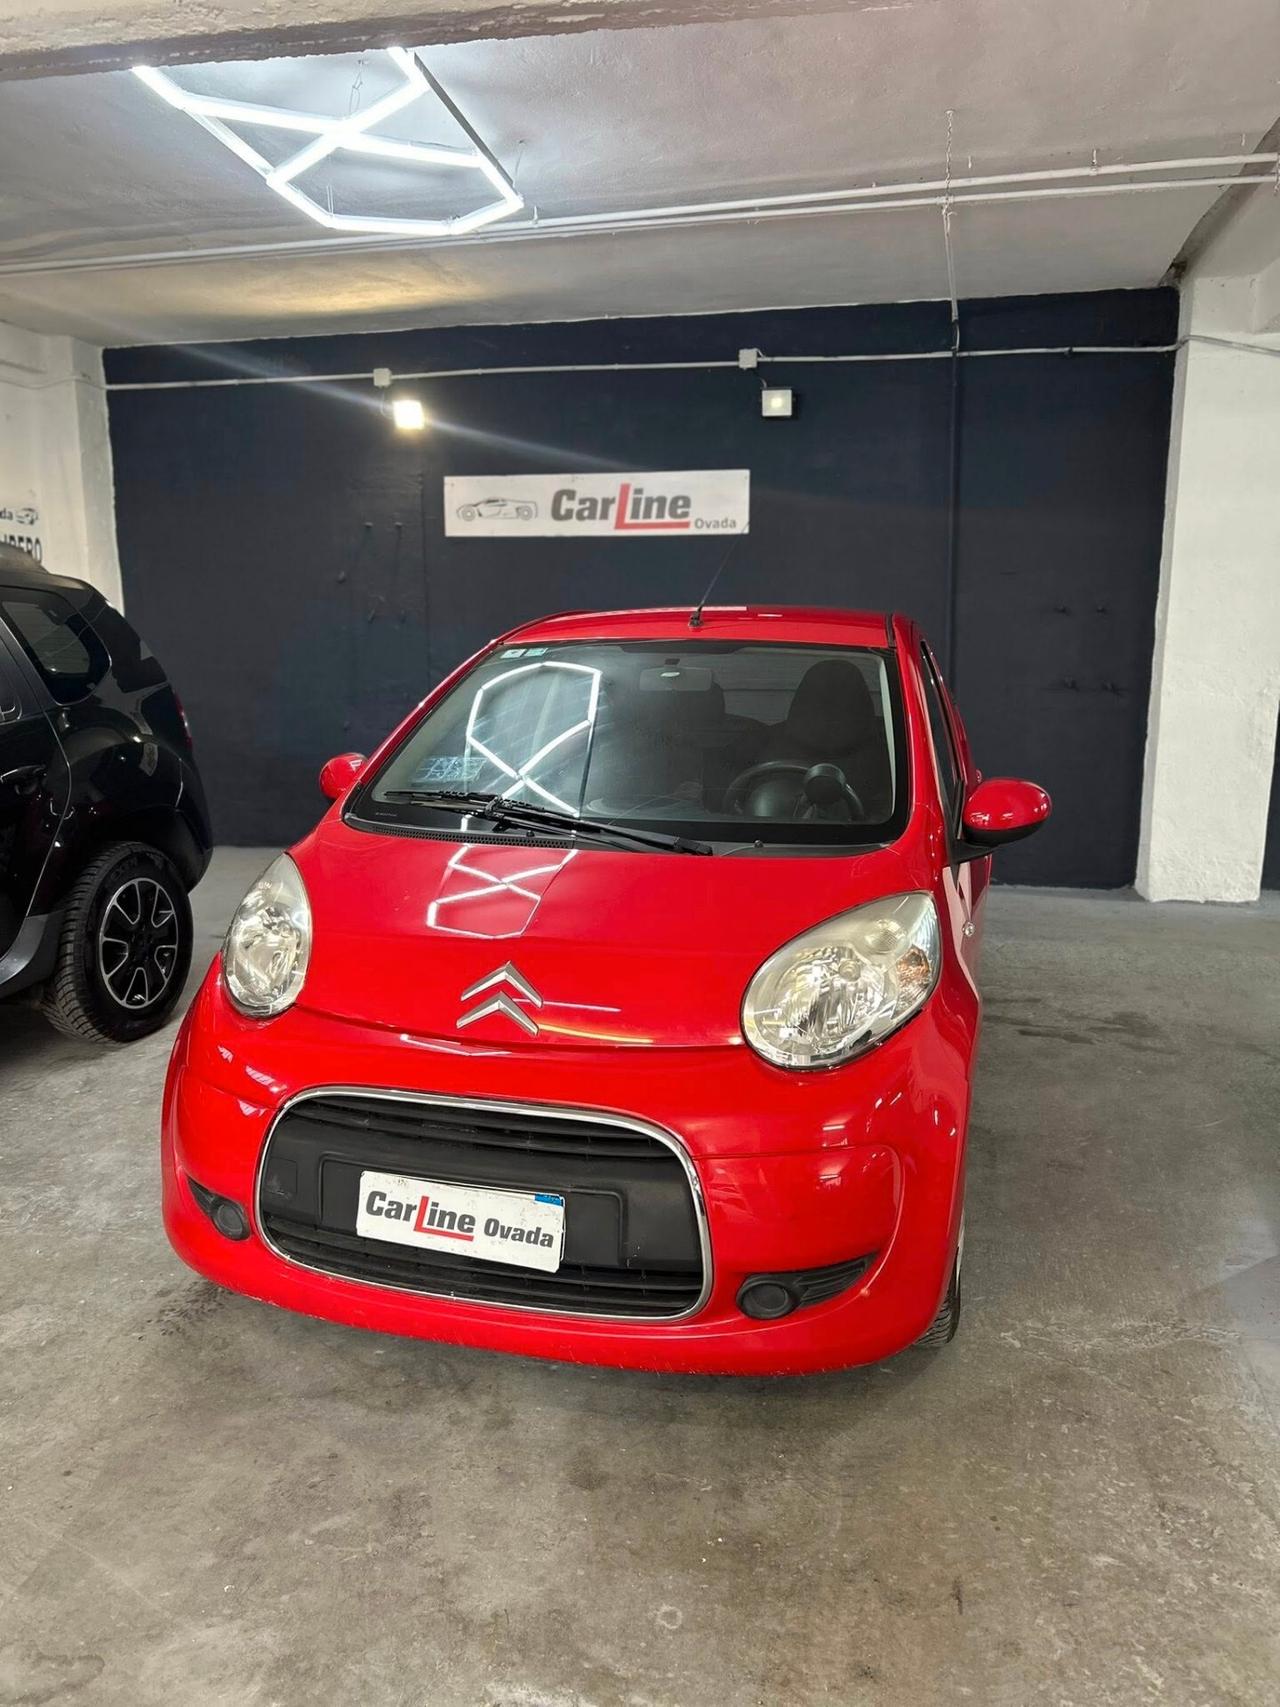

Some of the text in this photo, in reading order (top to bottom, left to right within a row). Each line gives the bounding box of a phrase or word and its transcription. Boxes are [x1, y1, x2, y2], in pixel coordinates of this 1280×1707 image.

[0, 508, 13, 521] da
[550, 483, 692, 530] CarLine
[694, 518, 737, 530] Ovada
[365, 1190, 554, 1249] CarLine Ovada
